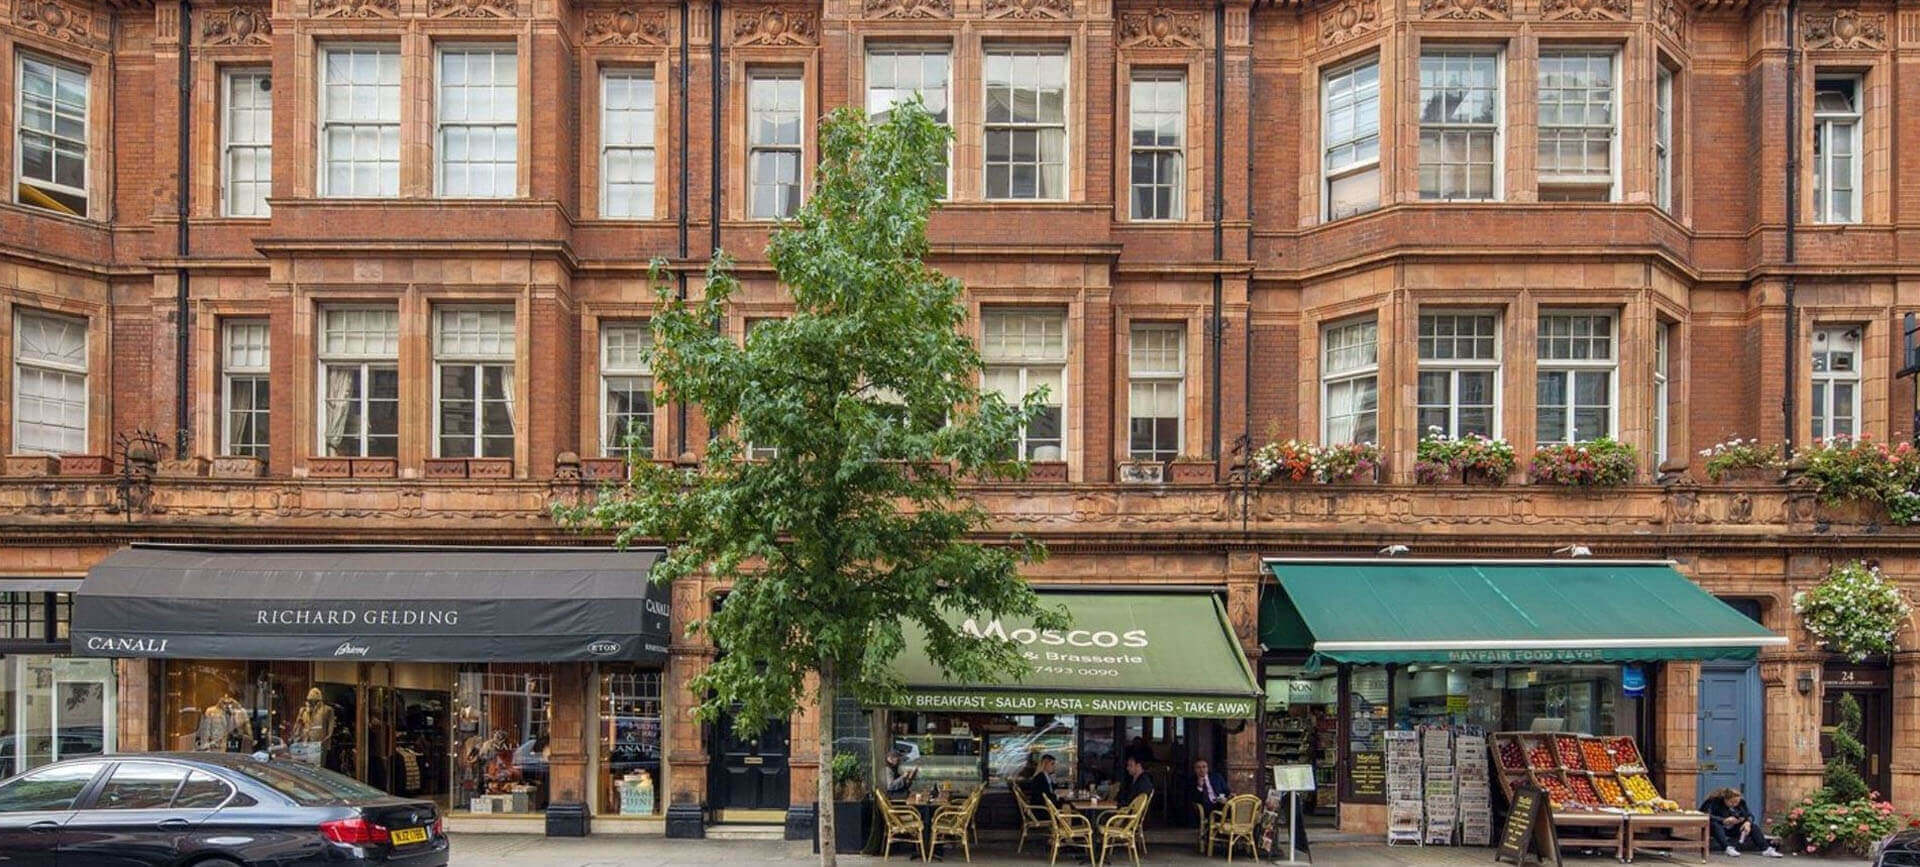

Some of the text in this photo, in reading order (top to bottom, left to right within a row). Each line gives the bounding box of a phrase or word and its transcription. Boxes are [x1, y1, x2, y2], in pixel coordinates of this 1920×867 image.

[257, 610, 459, 625] RICHARD GELDING
[87, 636, 168, 652] CANALI
[1023, 651, 1144, 664] & Brasserie
[1449, 650, 1511, 662] MAYFAIR
[1515, 651, 1554, 661] FOOD
[1035, 666, 1120, 677] 7493 0090
[1841, 671, 1854, 680] 24
[916, 695, 987, 708] BREAKFAST
[996, 697, 1036, 709] SALAD
[1045, 698, 1083, 710] PASTA
[1092, 699, 1174, 713] SANDWICHES
[1183, 701, 1213, 713] TAKE
[1217, 703, 1251, 714] AWAY
[615, 744, 653, 752] ANALI
